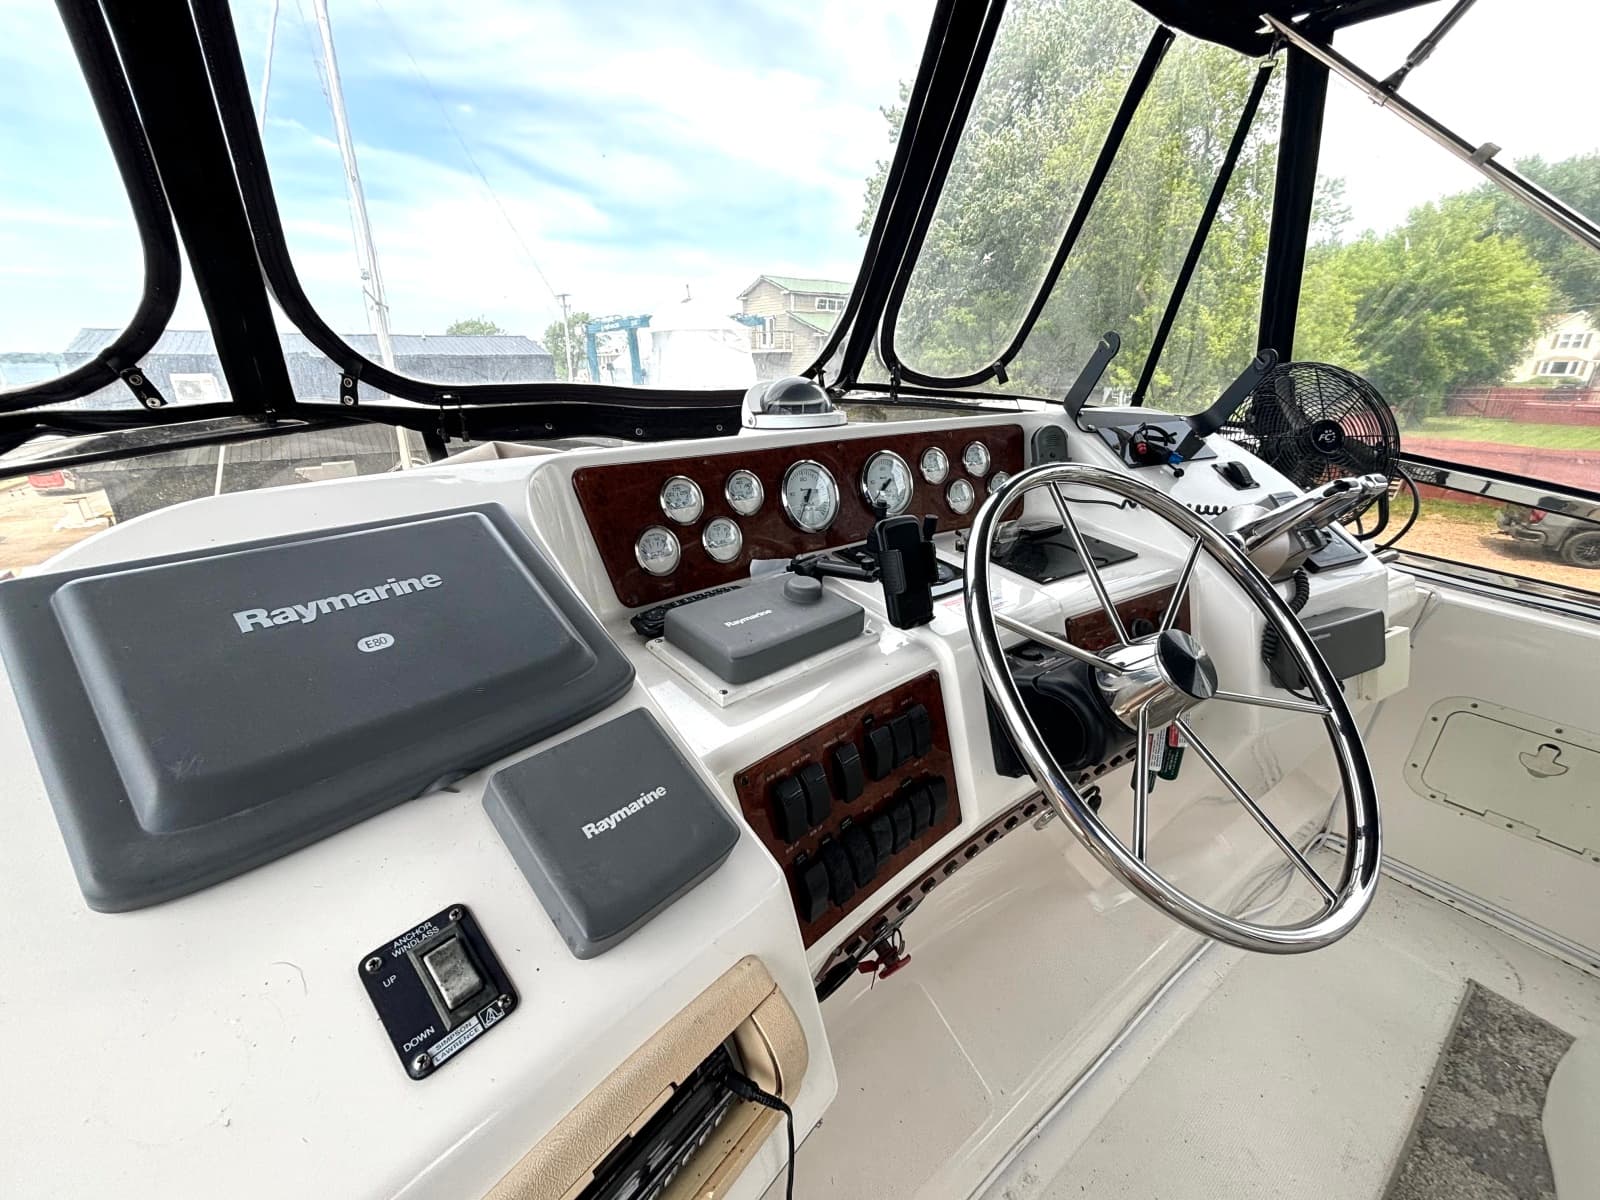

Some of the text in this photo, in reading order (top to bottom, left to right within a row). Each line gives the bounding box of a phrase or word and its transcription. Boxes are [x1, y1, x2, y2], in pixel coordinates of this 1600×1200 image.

[232, 571, 444, 634] Raymarine
[365, 636, 388, 650] E80
[581, 784, 667, 840] Raymarine
[391, 926, 440, 959] WINDLASS
[392, 921, 433, 949] ANCHOR
[382, 974, 397, 988] UP
[402, 1025, 436, 1053] DOWN
[434, 1026, 481, 1063] LAWRENCE
[435, 1021, 472, 1051] SIMPSON
